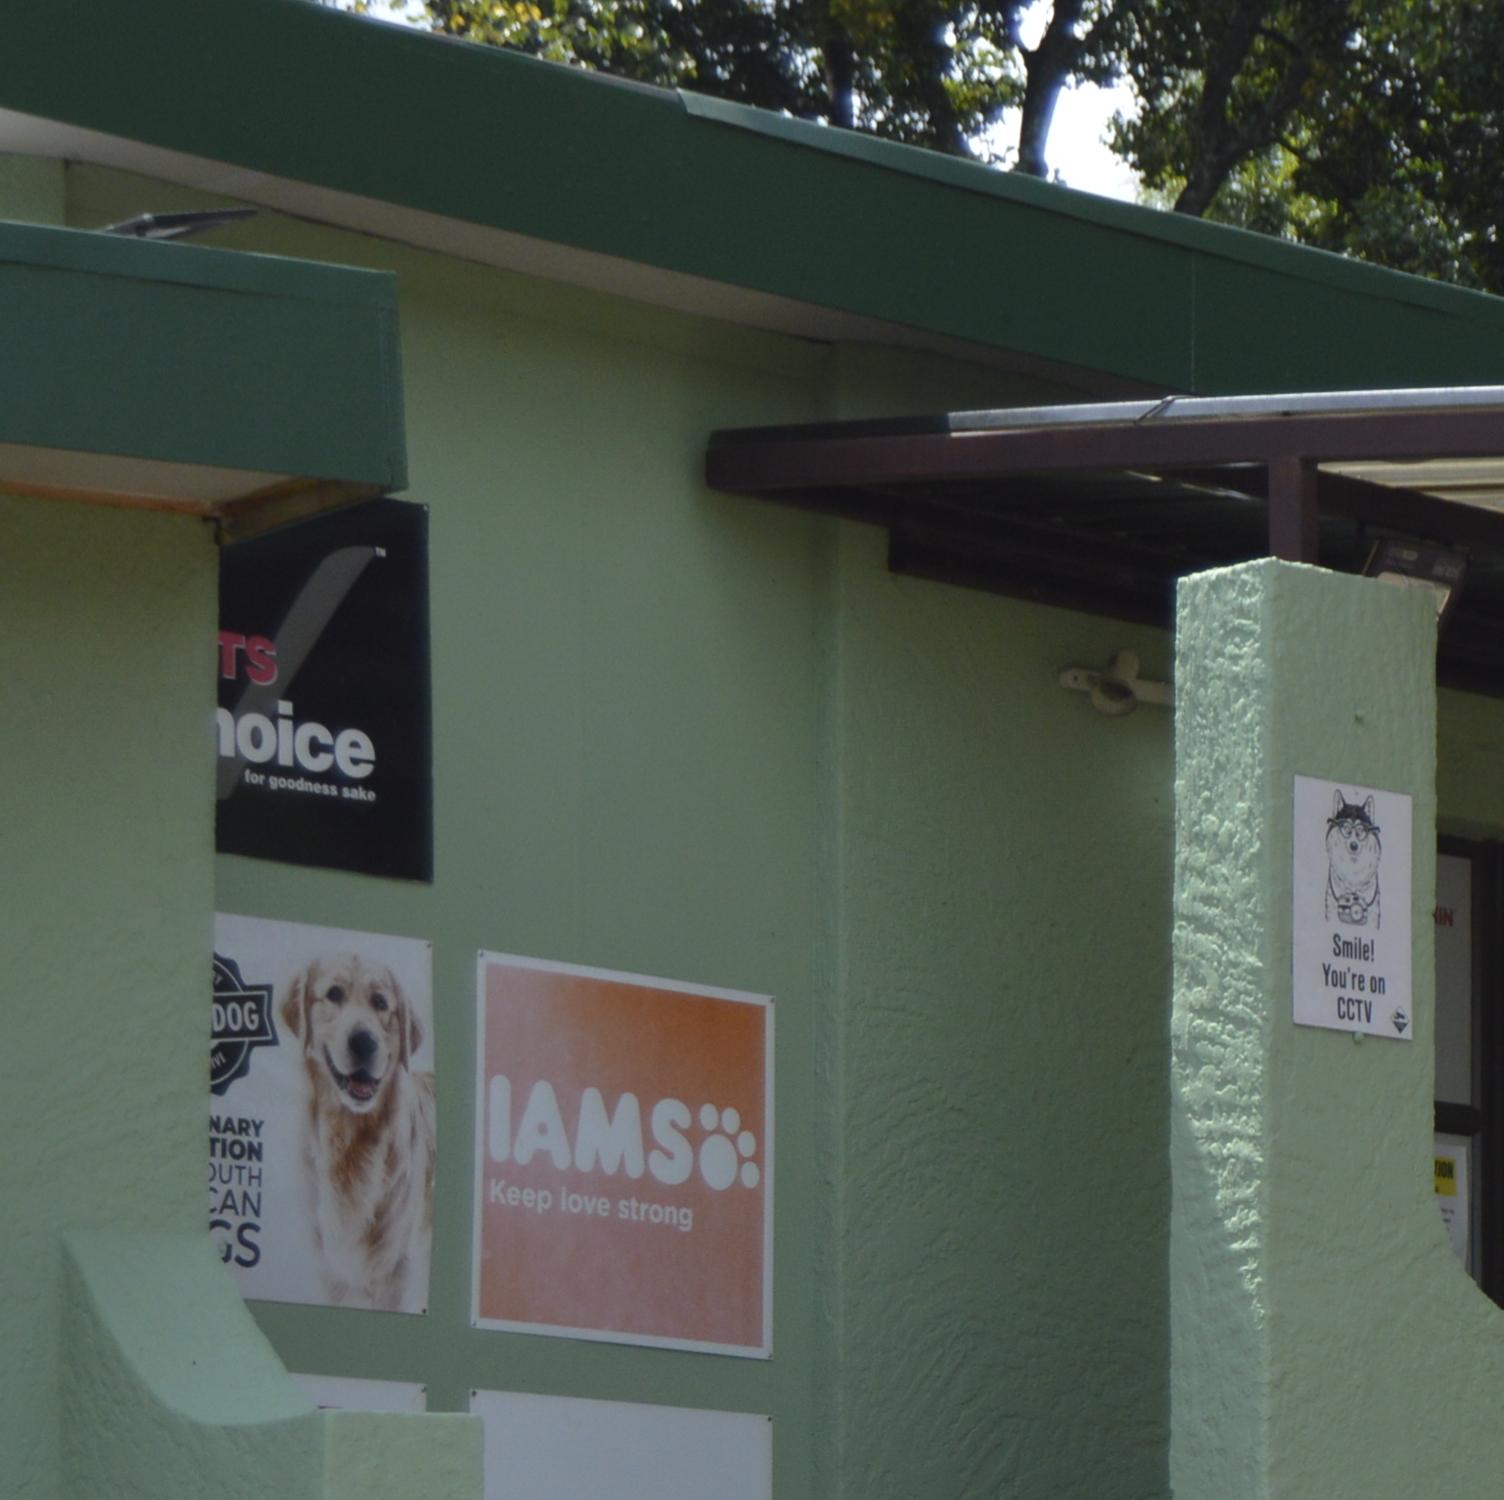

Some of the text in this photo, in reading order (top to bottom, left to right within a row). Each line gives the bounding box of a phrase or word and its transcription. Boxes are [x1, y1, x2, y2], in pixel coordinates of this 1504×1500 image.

[244, 769, 376, 802] for goodness sake
[1332, 933, 1375, 962] Smile!
[1321, 963, 1387, 995] You're on
[212, 1001, 260, 1032] DOG
[1337, 997, 1373, 1025] CCTV
[209, 1115, 265, 1137] NARY
[488, 1074, 694, 1186] IAMS
[490, 1179, 694, 1232] Keep love strong
